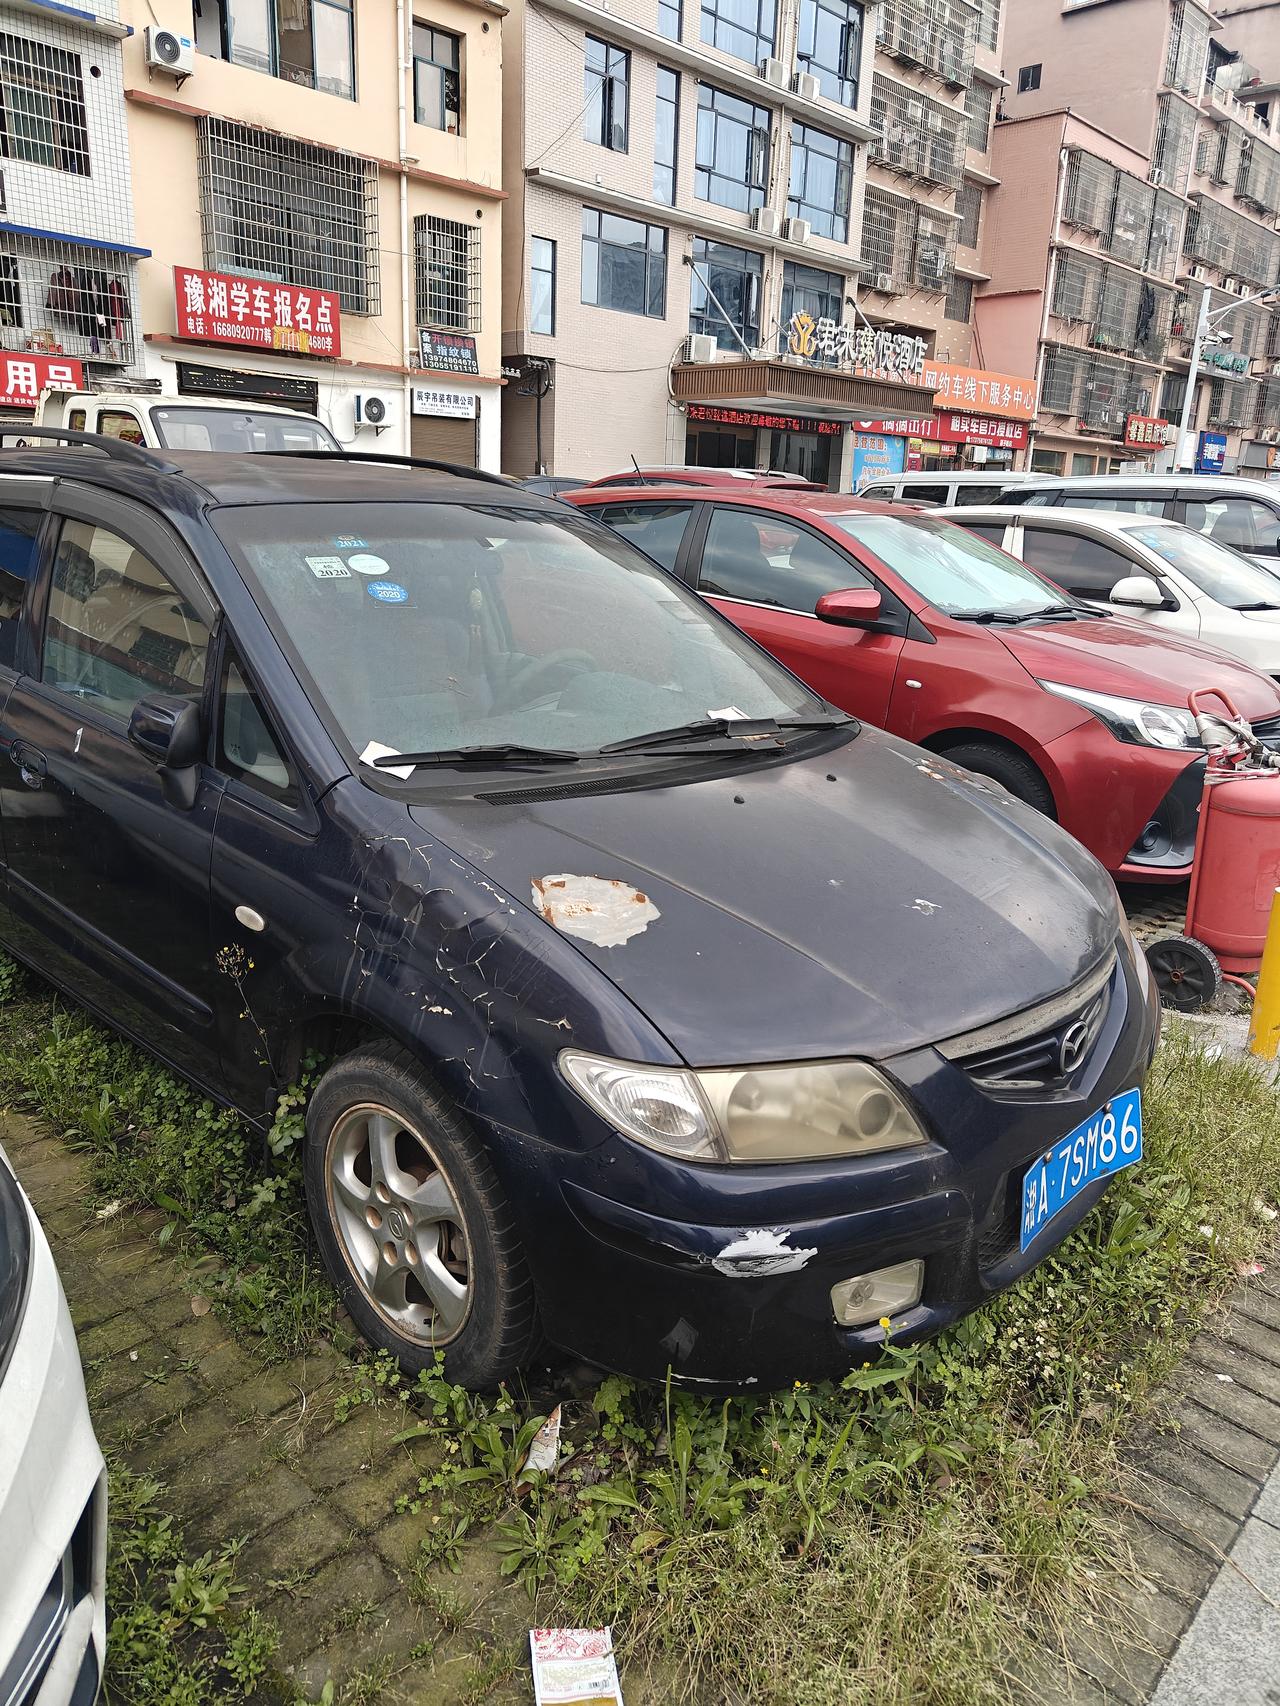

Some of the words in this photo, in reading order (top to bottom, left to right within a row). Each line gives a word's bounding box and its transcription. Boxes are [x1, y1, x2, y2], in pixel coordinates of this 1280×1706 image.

[183, 273, 334, 334] 豫湘学车报名点
[437, 345, 472, 360] 指纹锁
[425, 361, 478, 373] 13055191110
[6, 360, 77, 397] 用品
[925, 369, 1034, 410] 网约车线下服务中心
[416, 391, 474, 407] 辰宇吊装有限公司
[338, 540, 366, 548] 2021
[319, 569, 348, 577] 2020
[378, 590, 401, 599] 2020
